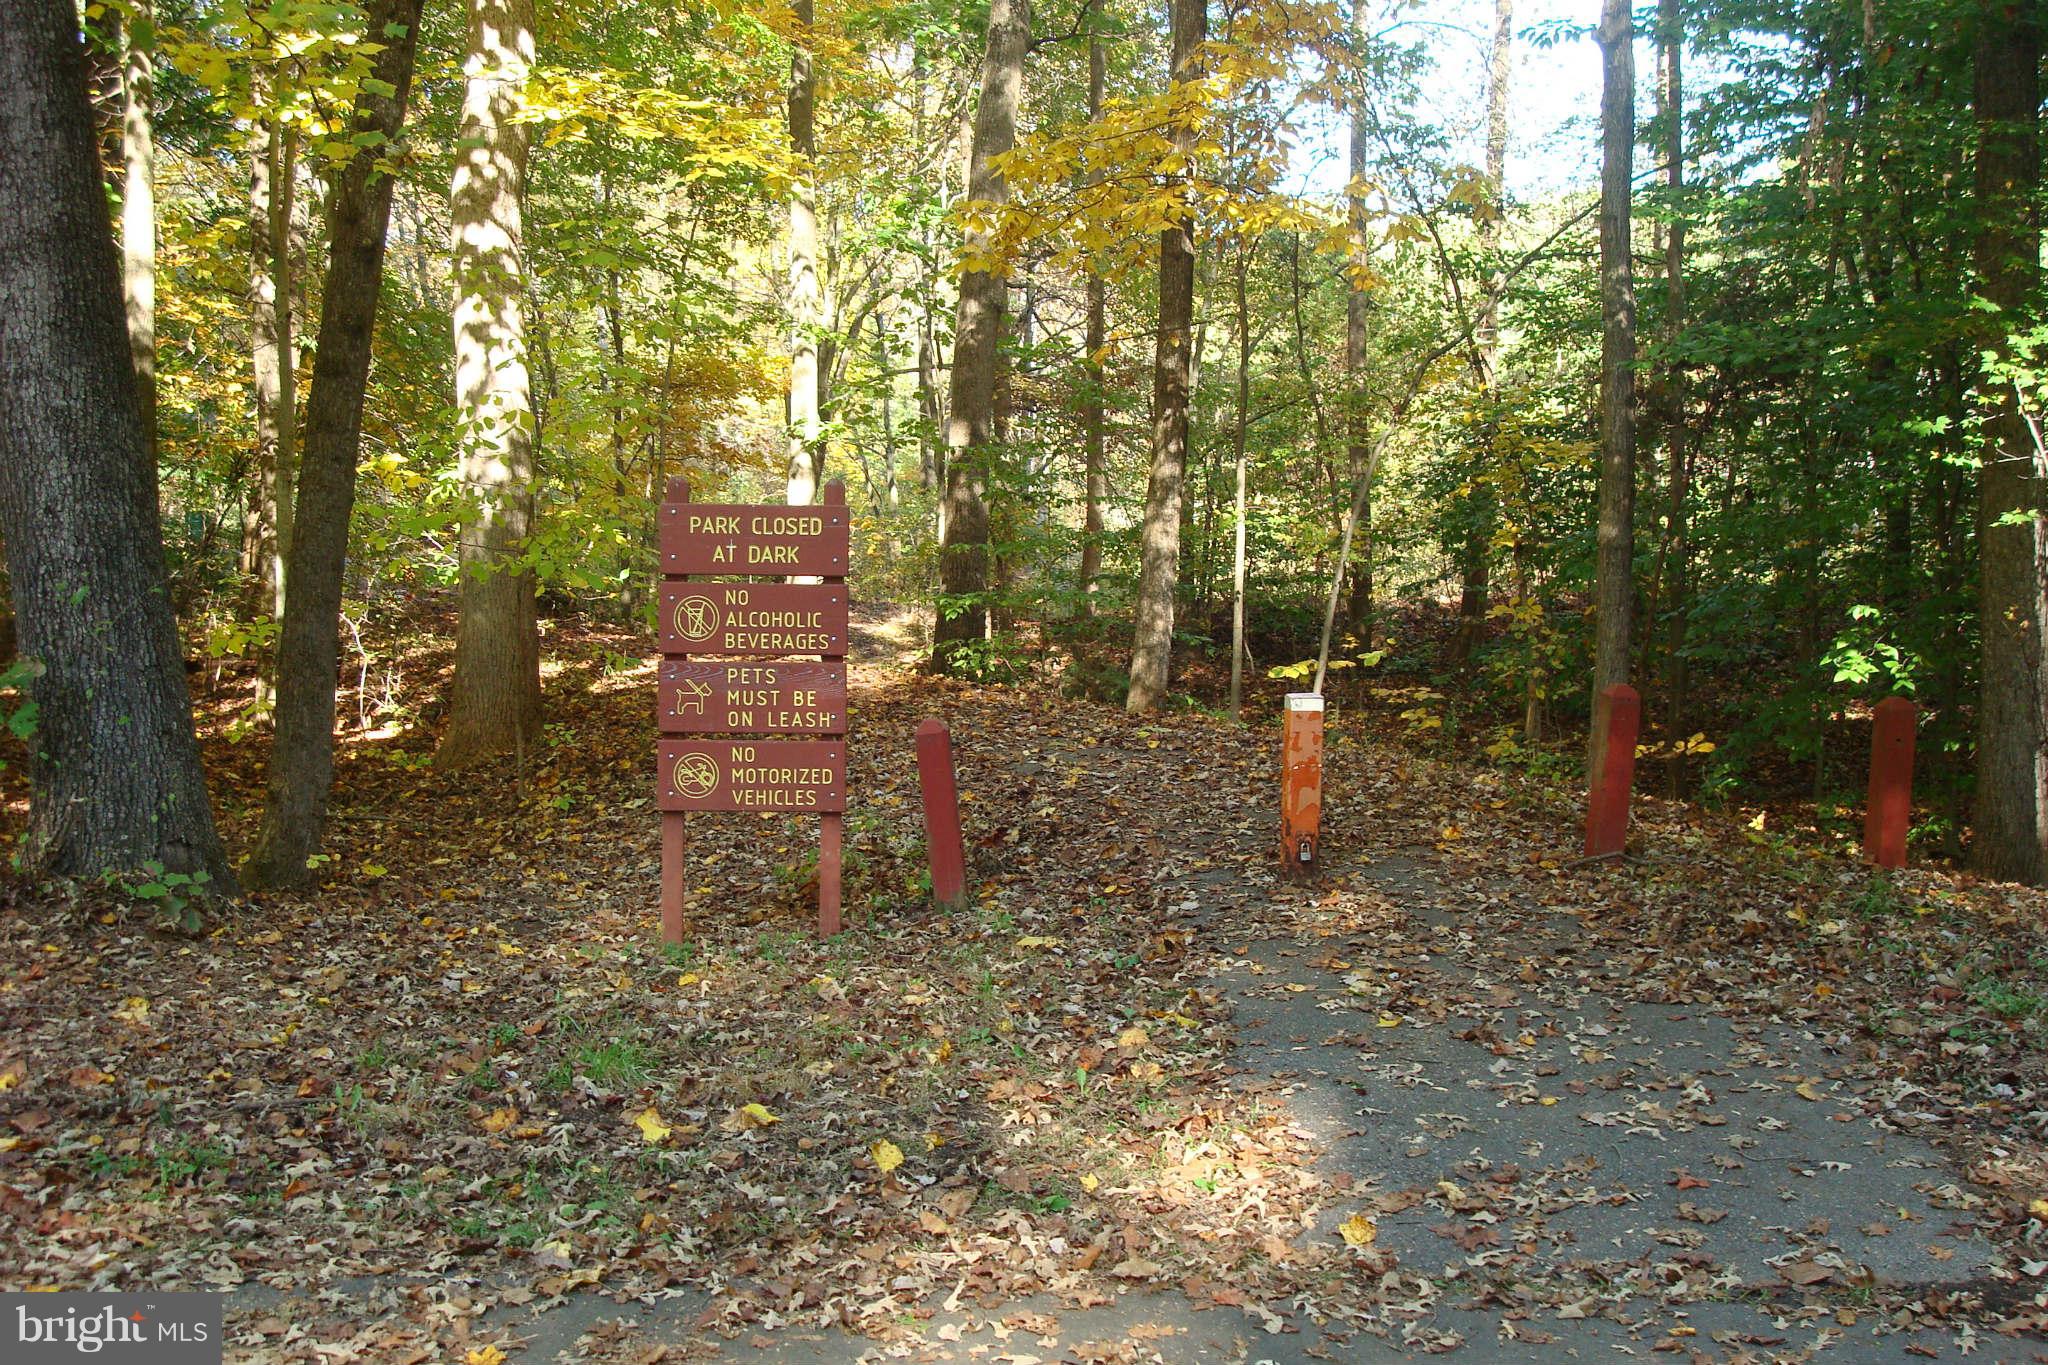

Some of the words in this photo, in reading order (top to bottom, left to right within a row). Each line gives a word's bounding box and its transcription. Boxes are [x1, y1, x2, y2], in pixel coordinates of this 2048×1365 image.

[689, 516, 741, 535] PARK
[751, 517, 823, 536] CLOSED
[712, 543, 737, 563] AT
[748, 545, 800, 564] DARK
[725, 589, 749, 606] NO
[725, 611, 822, 628] ALCOHOLIC
[725, 633, 829, 650] BEVERAGES
[727, 668, 776, 685] PETS
[727, 690, 780, 706] MUST
[793, 690, 817, 707] BE
[728, 711, 753, 727] ON
[768, 711, 831, 728] LEASH
[731, 746, 755, 763] NO
[731, 768, 833, 785] MOTORIZED
[732, 789, 817, 806] VEHICLES
